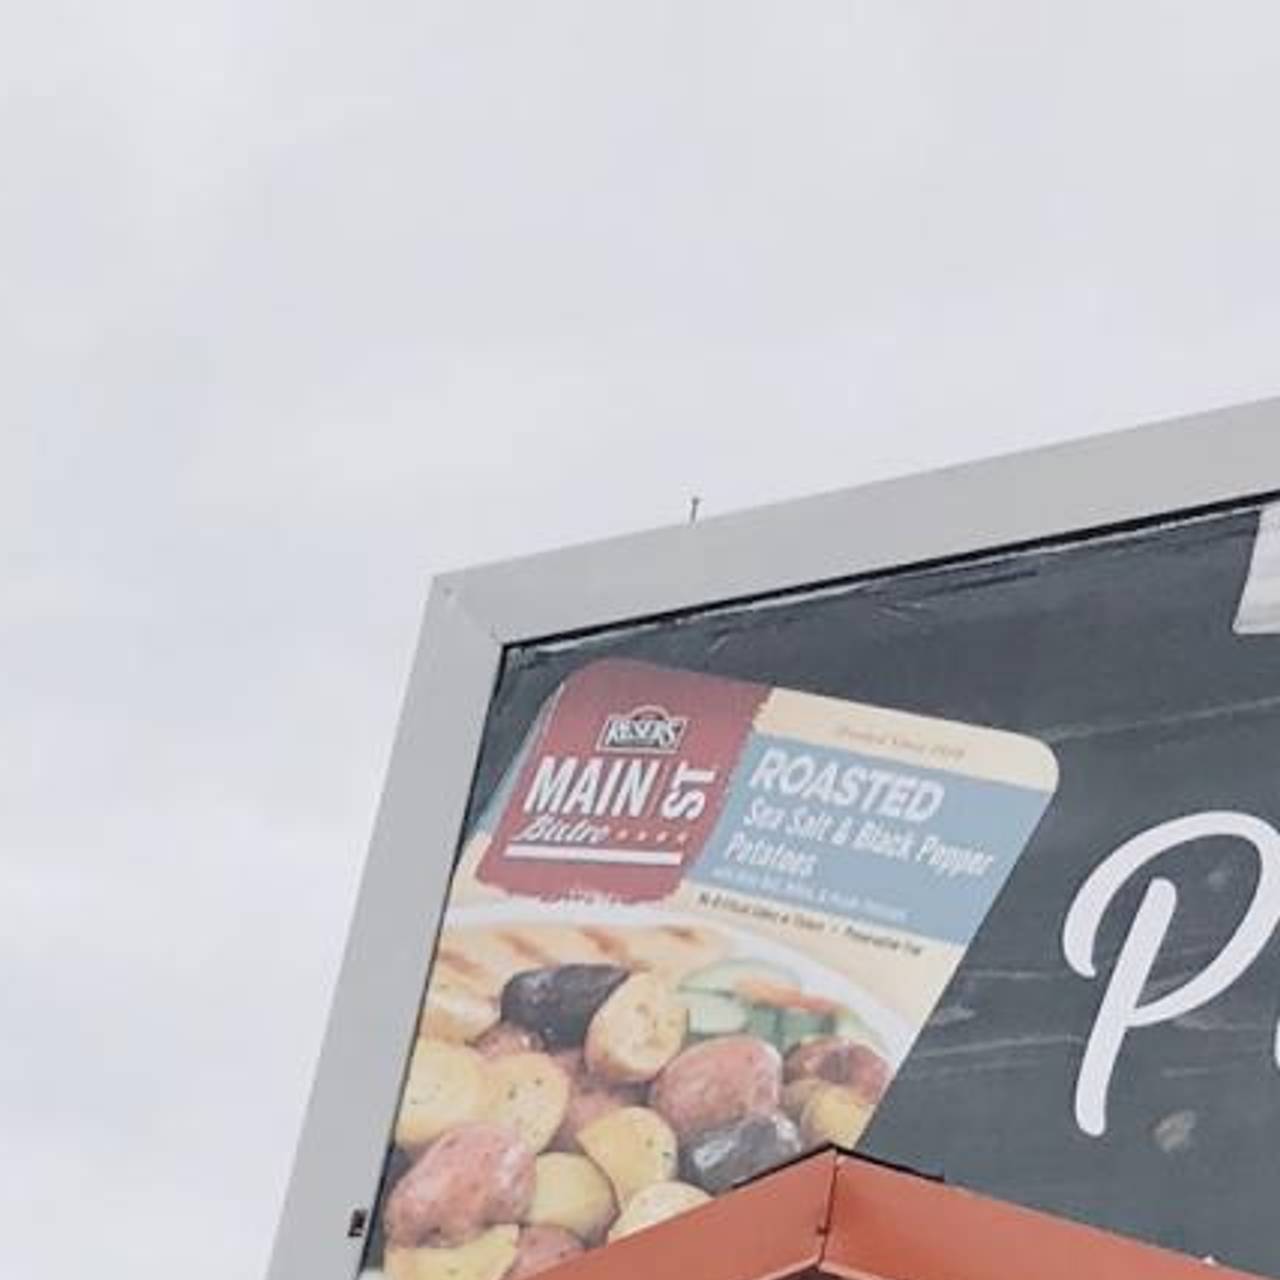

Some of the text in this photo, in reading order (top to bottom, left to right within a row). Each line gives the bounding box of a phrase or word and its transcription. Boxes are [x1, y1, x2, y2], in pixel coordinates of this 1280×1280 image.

[523, 756, 716, 820] MAIN ST
[749, 748, 945, 822] ROASTED
[724, 831, 817, 877] Potatoes
[744, 797, 786, 830] Sea
[786, 807, 835, 842] Salt
[853, 820, 917, 864] Black
[915, 836, 995, 878] Pepper
